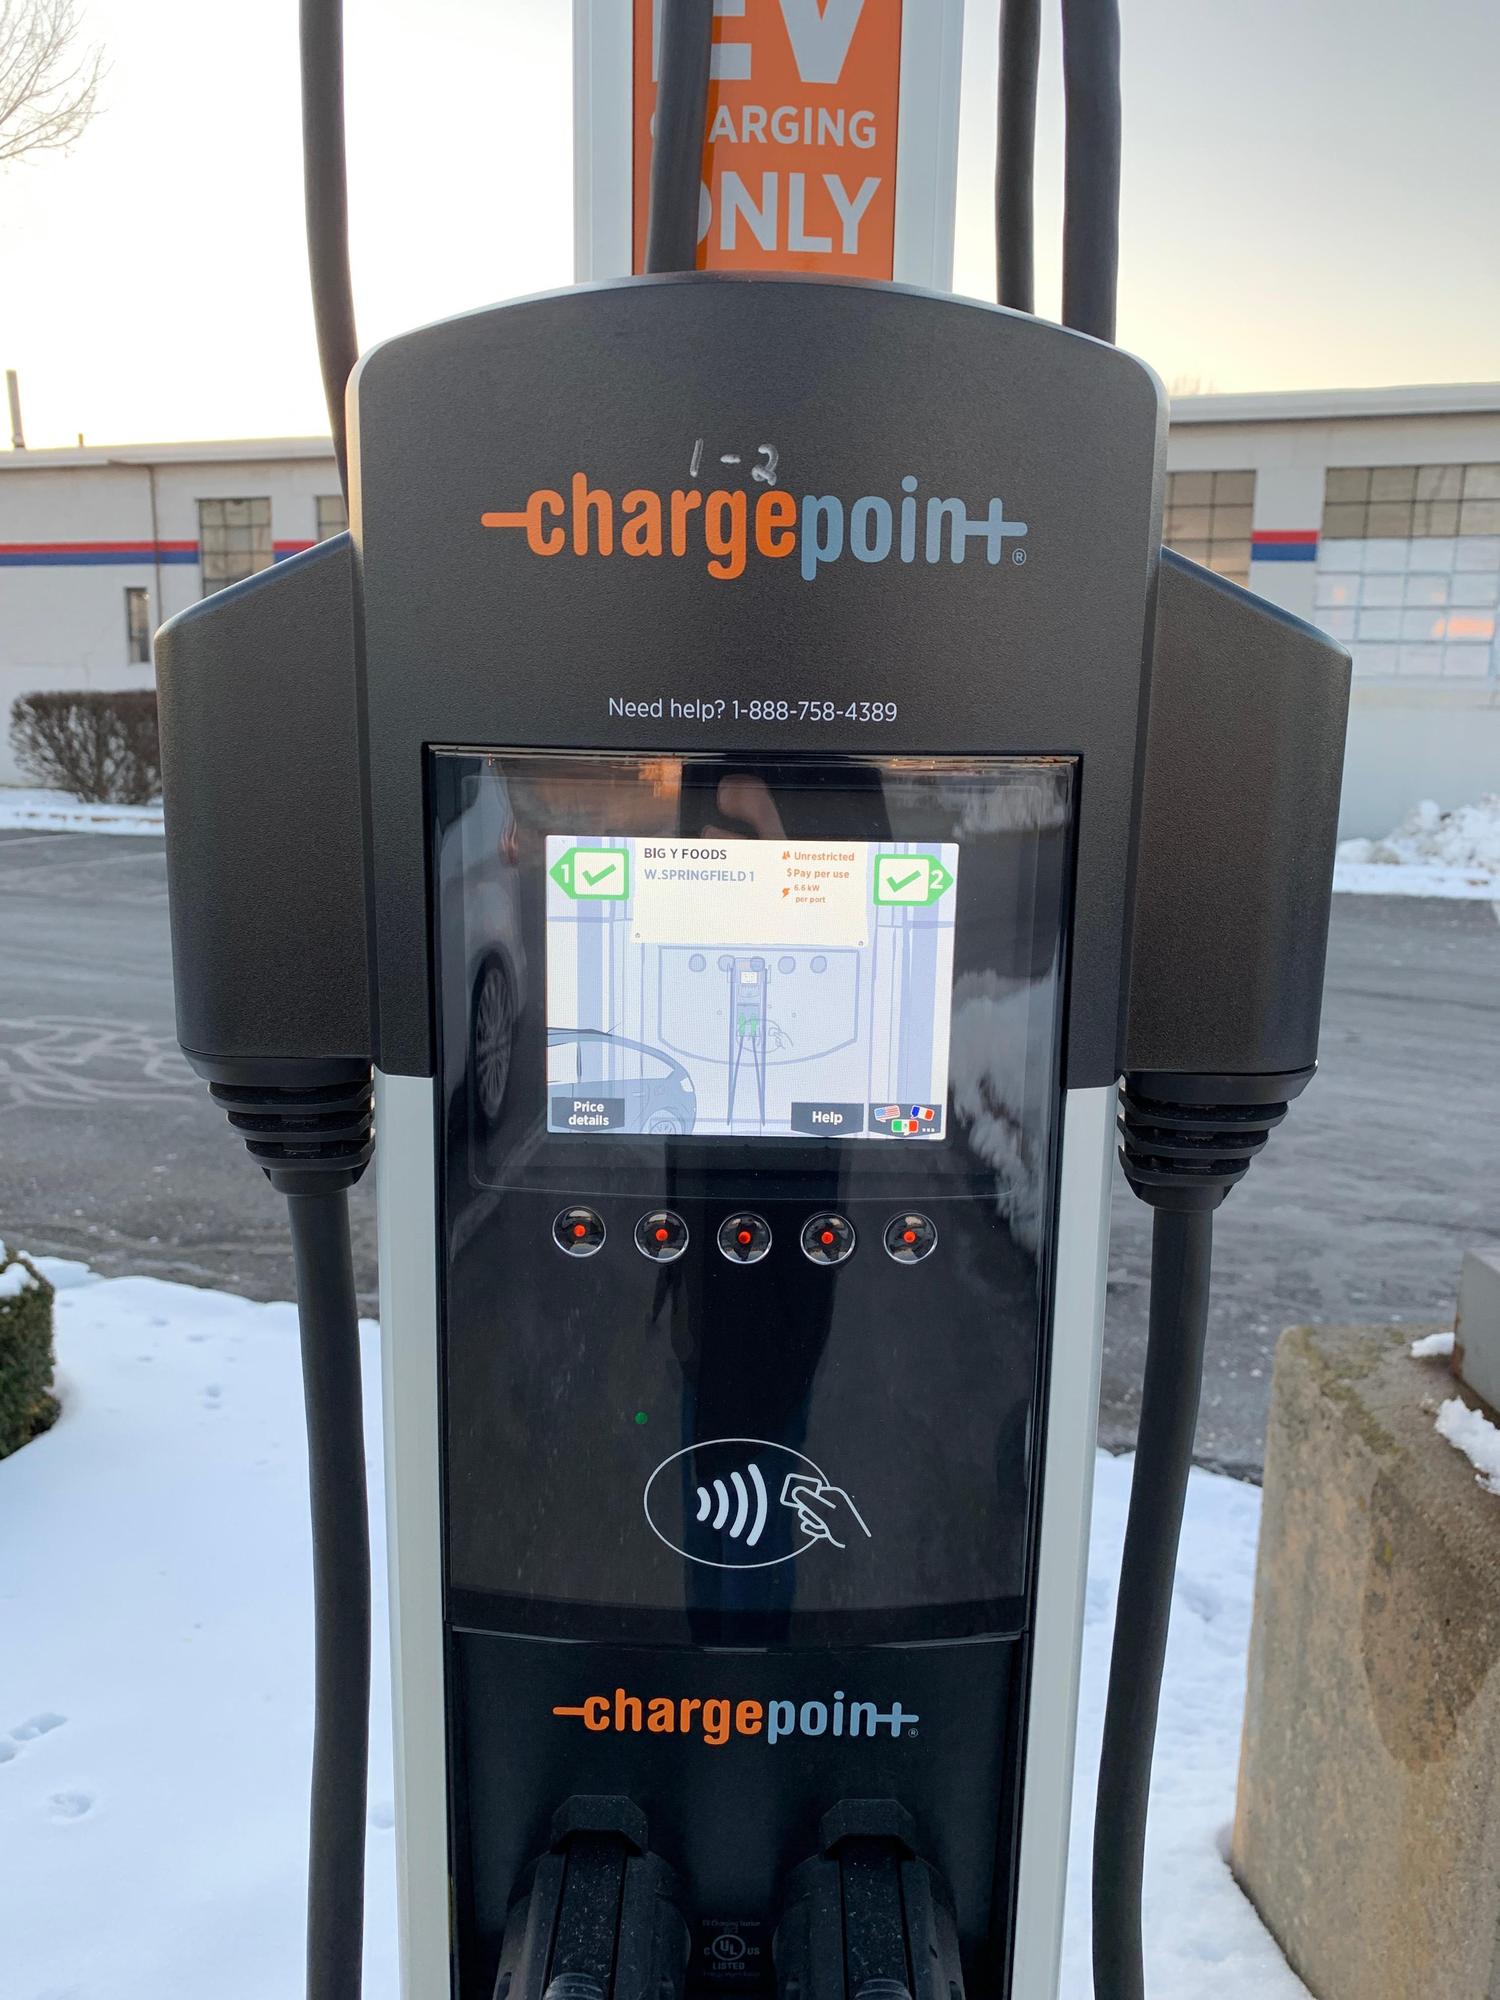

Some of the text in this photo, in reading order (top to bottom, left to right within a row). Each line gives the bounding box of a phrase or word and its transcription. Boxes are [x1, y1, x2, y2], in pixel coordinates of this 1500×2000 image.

[650, 105, 876, 148] ARGING
[697, 171, 882, 254] NLY
[608, 697, 898, 722] Need help? 1-888-758-4389
[644, 847, 727, 860] BIG Y FOODS
[794, 851, 855, 862] Unrestricted
[561, 863, 570, 884] 1
[644, 868, 747, 882] W.SPRINGFIELD
[793, 868, 812, 880] Pay
[814, 870, 830, 880] per
[832, 870, 850, 879] use
[929, 869, 944, 890] 2
[573, 1101, 605, 1112] Price
[568, 1114, 610, 1126] details
[812, 1111, 843, 1125] Help
[712, 1961, 745, 1970] LISTED
